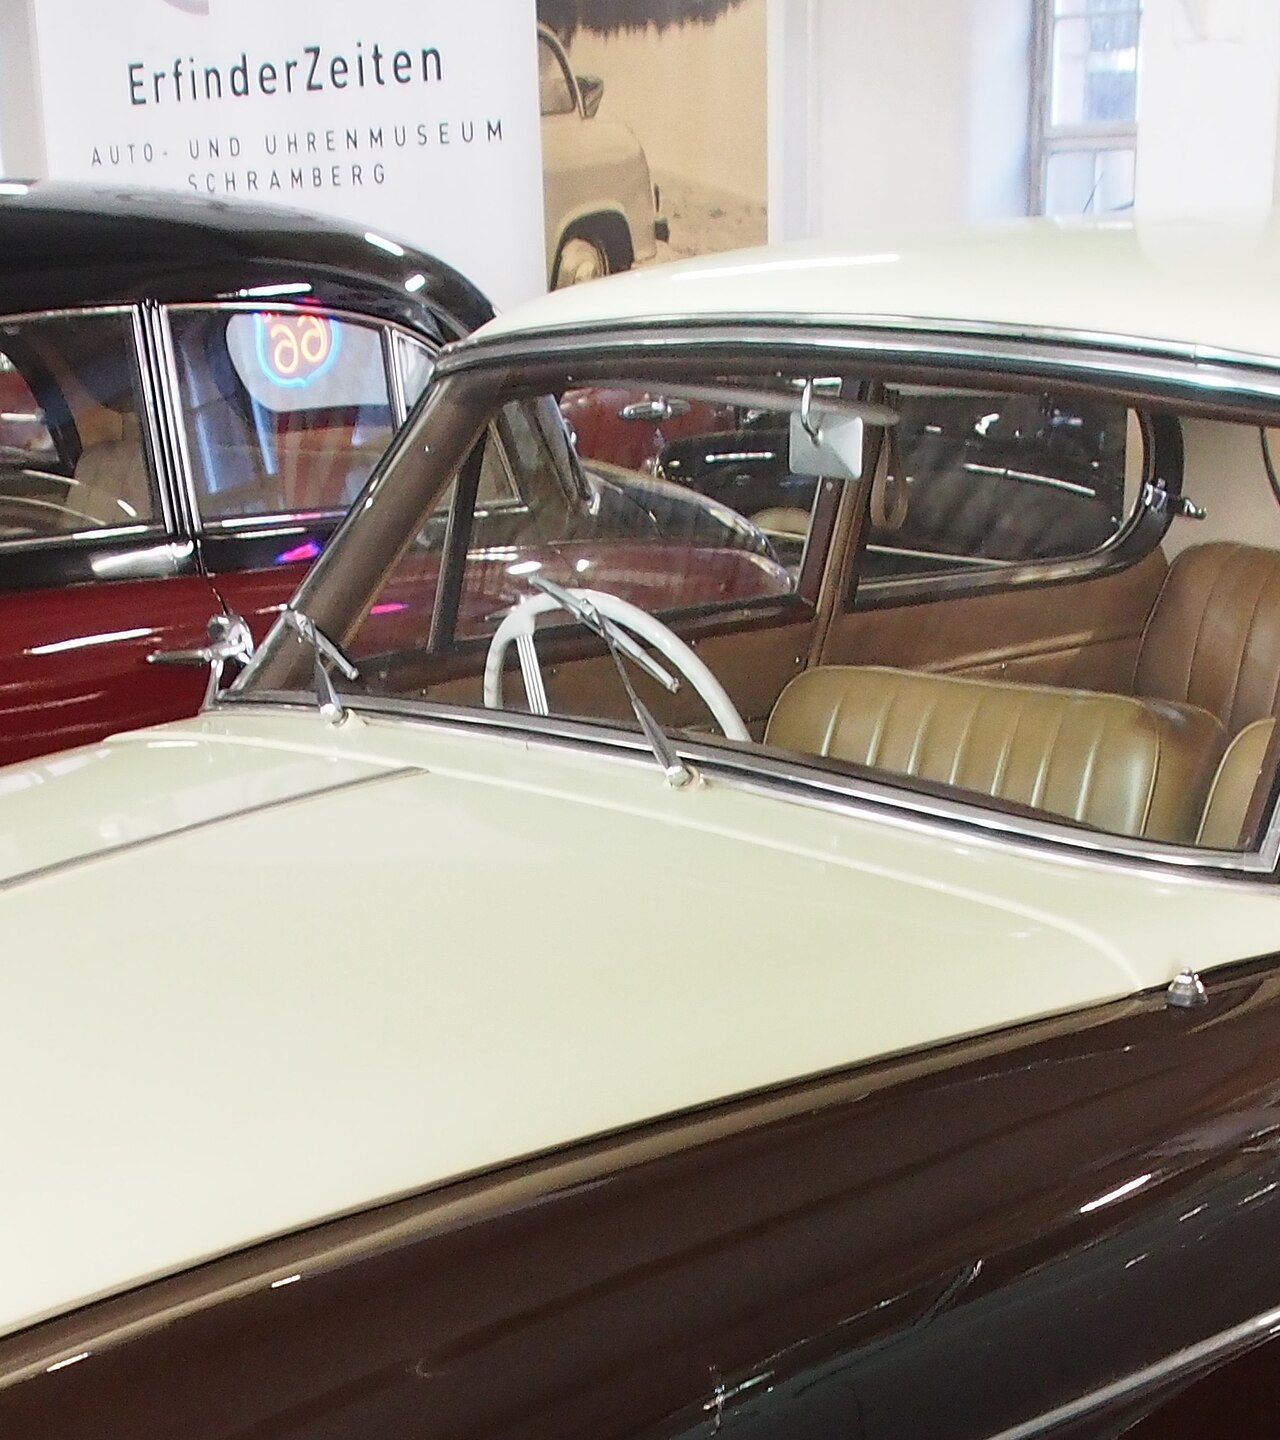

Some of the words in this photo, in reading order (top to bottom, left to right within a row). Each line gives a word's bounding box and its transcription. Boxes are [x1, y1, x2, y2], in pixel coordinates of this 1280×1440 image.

[127, 41, 442, 105] ErfinderZeiten
[91, 142, 169, 167] AUTO-
[188, 136, 241, 160] UND
[265, 119, 504, 155] UHRENMUSEUM
[188, 163, 386, 193] SCHRAMBERG
